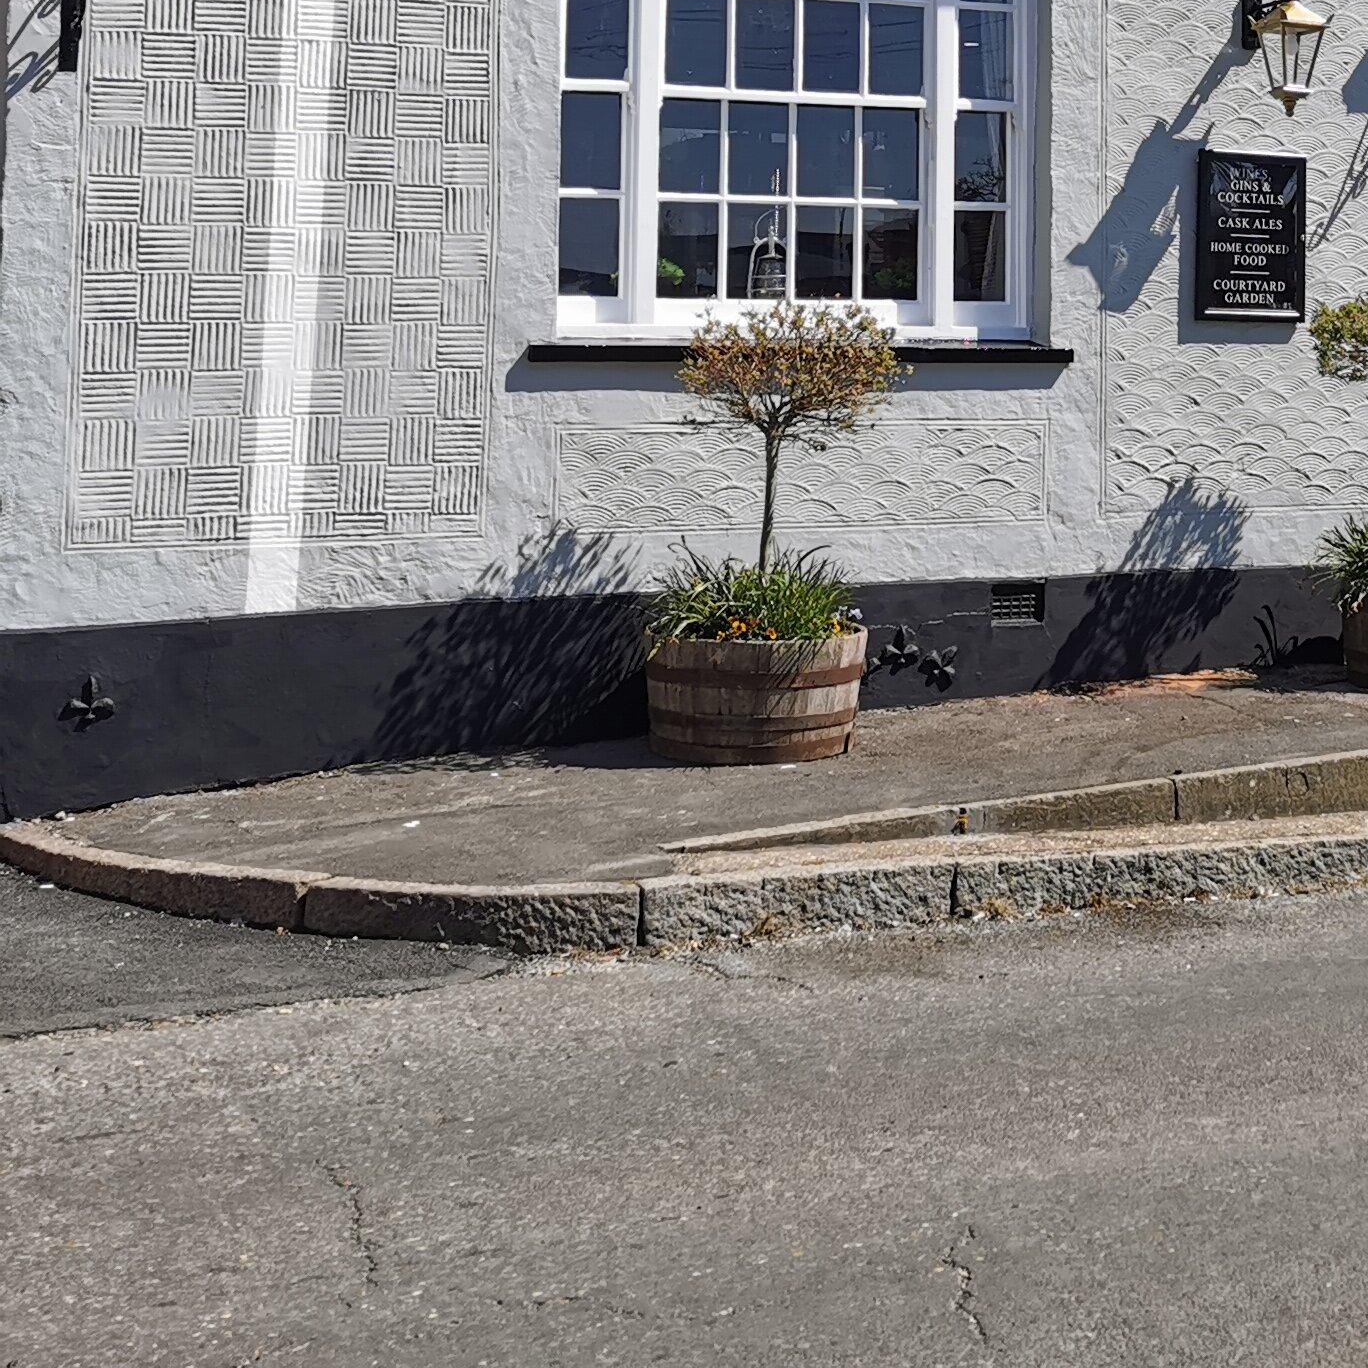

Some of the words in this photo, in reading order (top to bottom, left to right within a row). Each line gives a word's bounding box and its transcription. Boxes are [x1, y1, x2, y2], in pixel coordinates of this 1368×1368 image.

[1230, 167, 1271, 182] WINES,
[1231, 180, 1259, 191] GINS
[1262, 182, 1272, 192] &
[1217, 192, 1284, 205] COCKTAILS
[1218, 217, 1250, 229] CASK
[1253, 219, 1283, 230] ALES
[1210, 242, 1242, 253] HOME
[1245, 243, 1289, 255] COOKED
[1233, 255, 1267, 266] FOOD
[1213, 280, 1285, 292] COURTYARD
[1224, 293, 1275, 305] GARDEN
